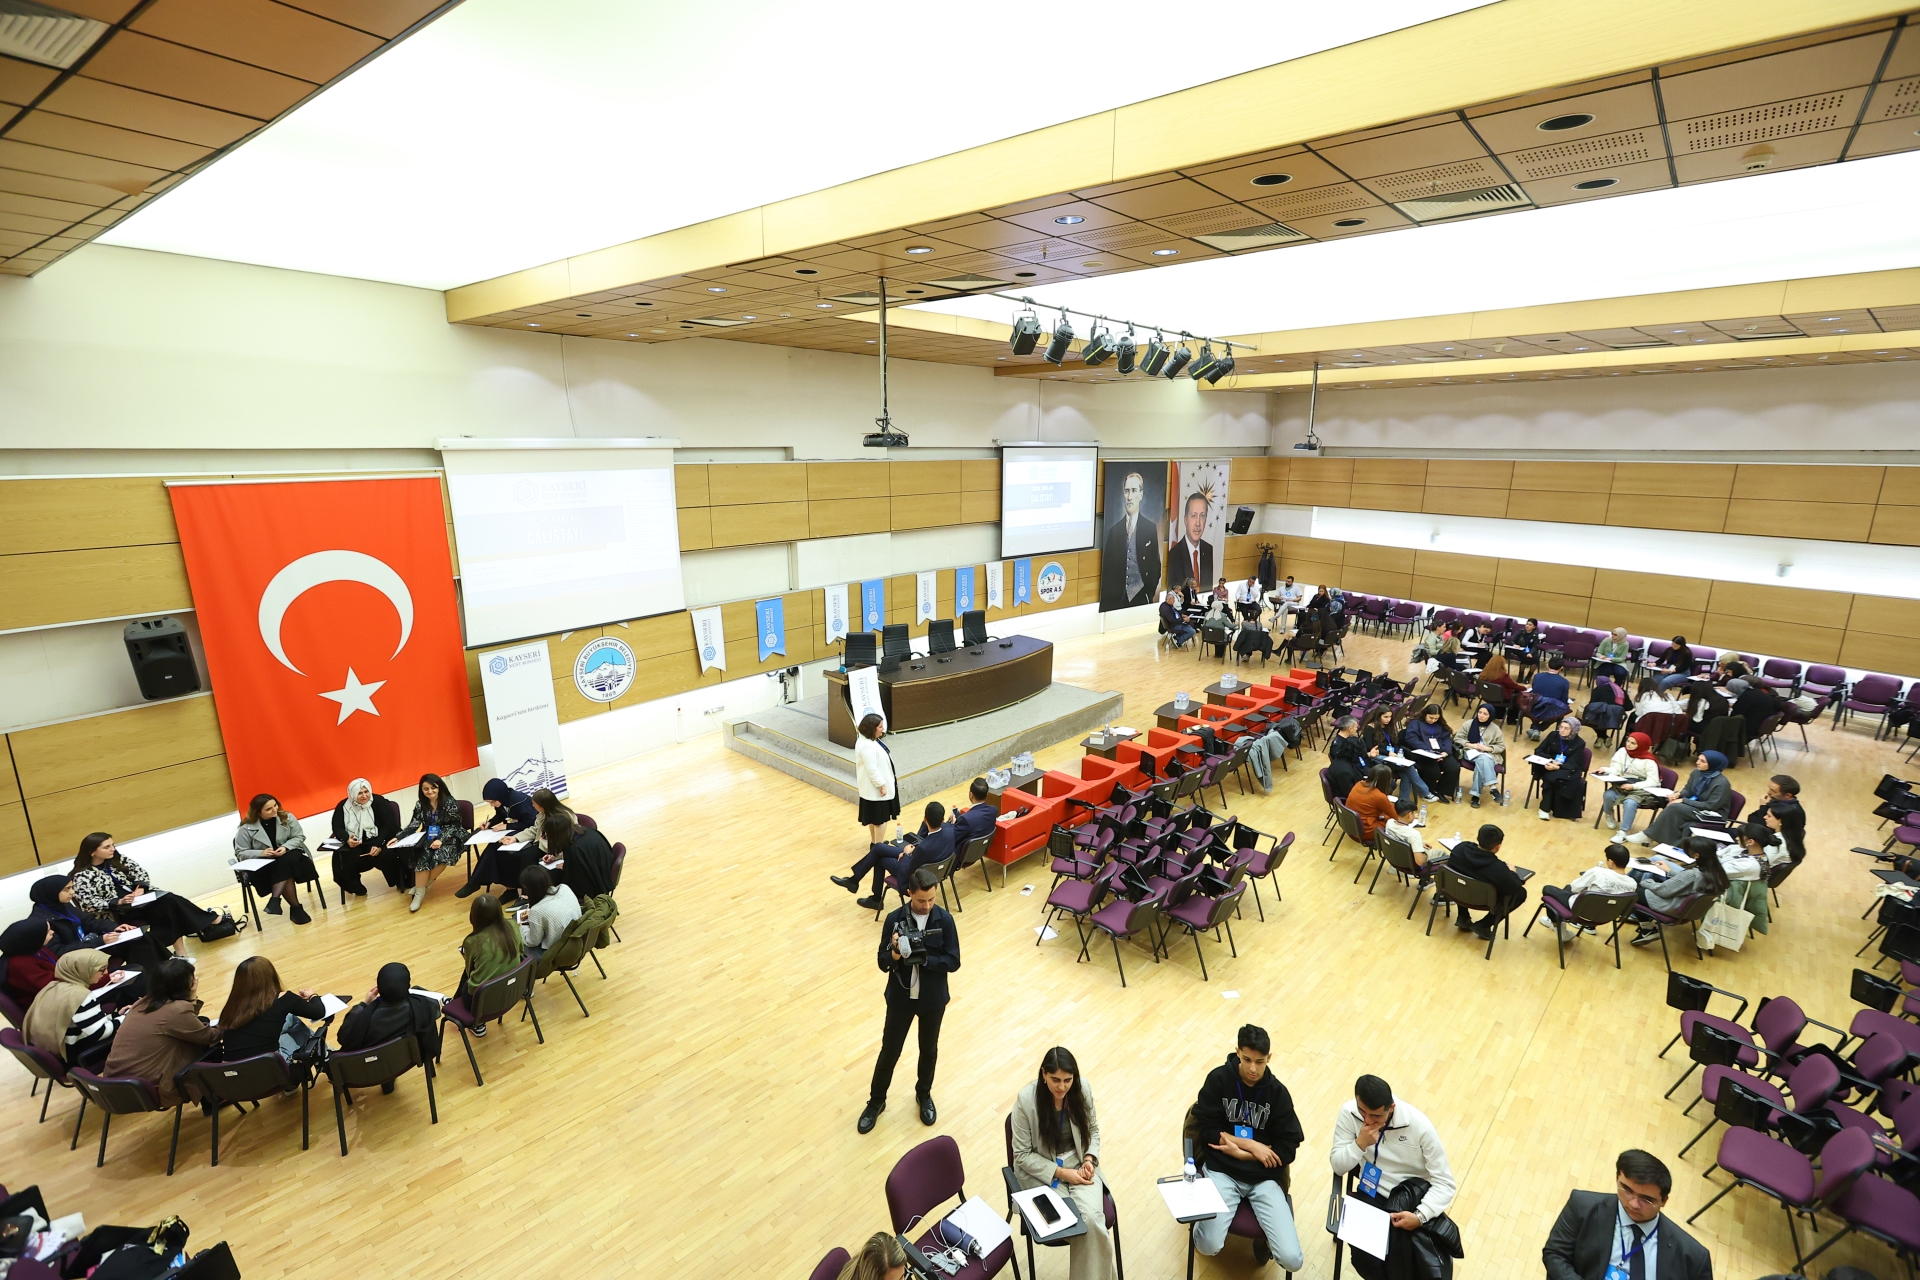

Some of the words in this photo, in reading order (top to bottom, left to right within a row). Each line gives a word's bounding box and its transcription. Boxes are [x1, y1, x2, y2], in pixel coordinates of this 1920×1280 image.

[541, 479, 587, 491] KAYSERİ
[1040, 587, 1053, 595] SPOR
[508, 649, 541, 663] KAYSERİ
